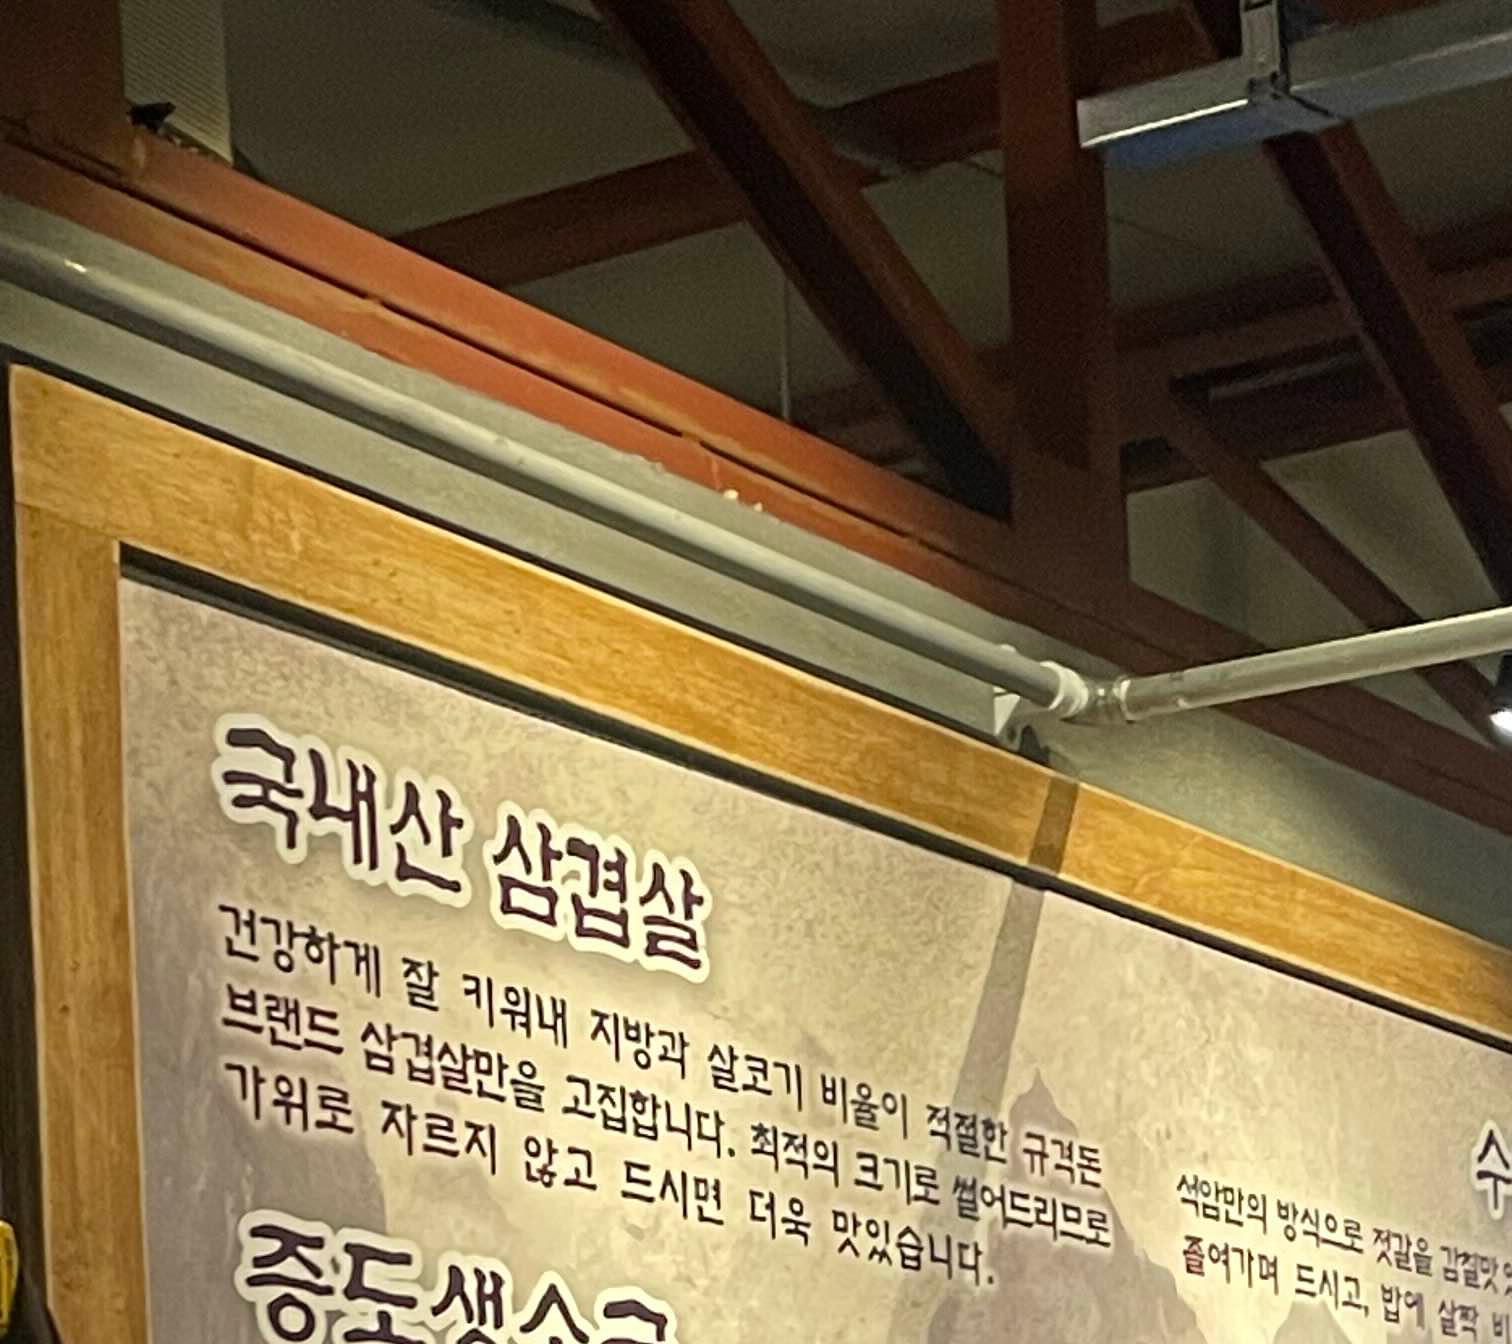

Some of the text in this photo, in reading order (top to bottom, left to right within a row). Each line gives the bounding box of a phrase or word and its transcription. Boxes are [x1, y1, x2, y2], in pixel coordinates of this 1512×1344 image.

[222, 727, 704, 970] 국내산 삼겹살
[219, 904, 1102, 1188] 건강하게 잘 키워내 지방과 살코기 비율이 적절한 규격돈
[222, 983, 1111, 1248] 브랜드 삼겹살만을 고집합니다. 최적의 크기로 썰어드리므로
[224, 1063, 995, 1286] 가위로 자르지 않고 드시면 더욱 맛있습니다.
[1176, 1174, 1267, 1235] 석암만의
[1276, 1199, 1364, 1254] 방식으로
[1372, 1227, 1433, 1277] 젓갈을
[1295, 1264, 1369, 1318] 드시고,
[1380, 1283, 1425, 1330] 밥에
